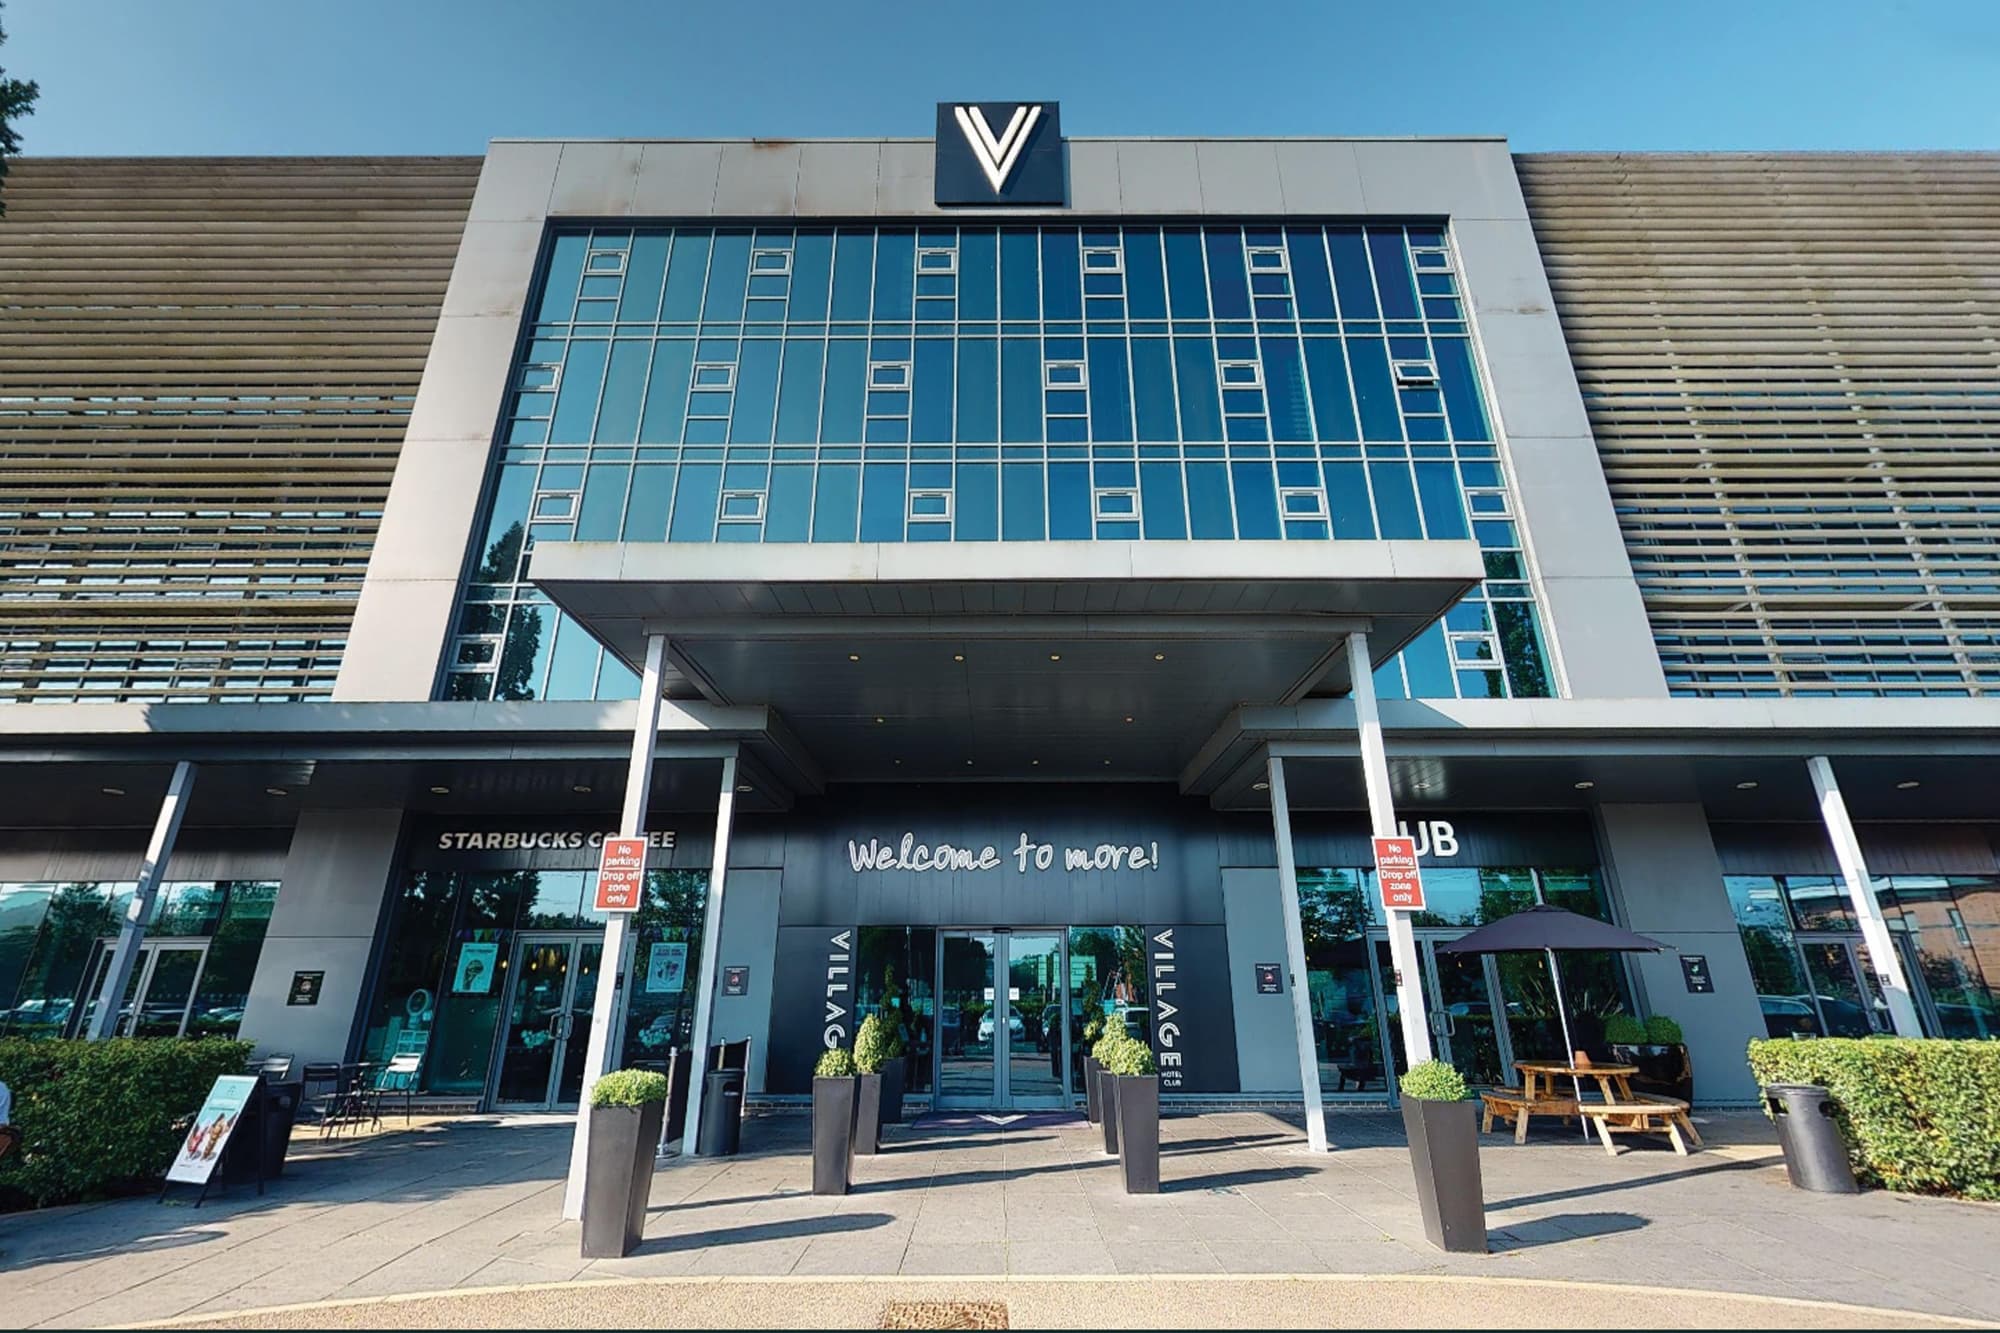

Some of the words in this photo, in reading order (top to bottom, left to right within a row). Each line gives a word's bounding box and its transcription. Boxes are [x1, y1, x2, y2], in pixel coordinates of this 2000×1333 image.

[954, 106, 1042, 194] V
[439, 832, 582, 848] STARBUCKS
[587, 831, 675, 848] CEE
[1399, 821, 1458, 856] UB
[617, 845, 632, 855] No
[848, 832, 1000, 872] Welcome
[1013, 832, 1052, 872] to
[1065, 841, 1159, 871] more!
[1388, 844, 1401, 853] No
[605, 856, 640, 867] parking
[1380, 855, 1413, 866] parking
[602, 871, 625, 882] Drop
[626, 871, 640, 881] off
[1381, 869, 1403, 881] Drop
[1404, 869, 1417, 879] off
[607, 884, 631, 892] zone
[1390, 882, 1412, 891] zone
[606, 894, 628, 905] only
[1393, 893, 1413, 904] only
[823, 930, 851, 1049] VILLAG
[1153, 928, 1182, 1066] VILLAGE
[1161, 1070, 1183, 1078] HOTEL
[1163, 1078, 1181, 1087] CLUB
